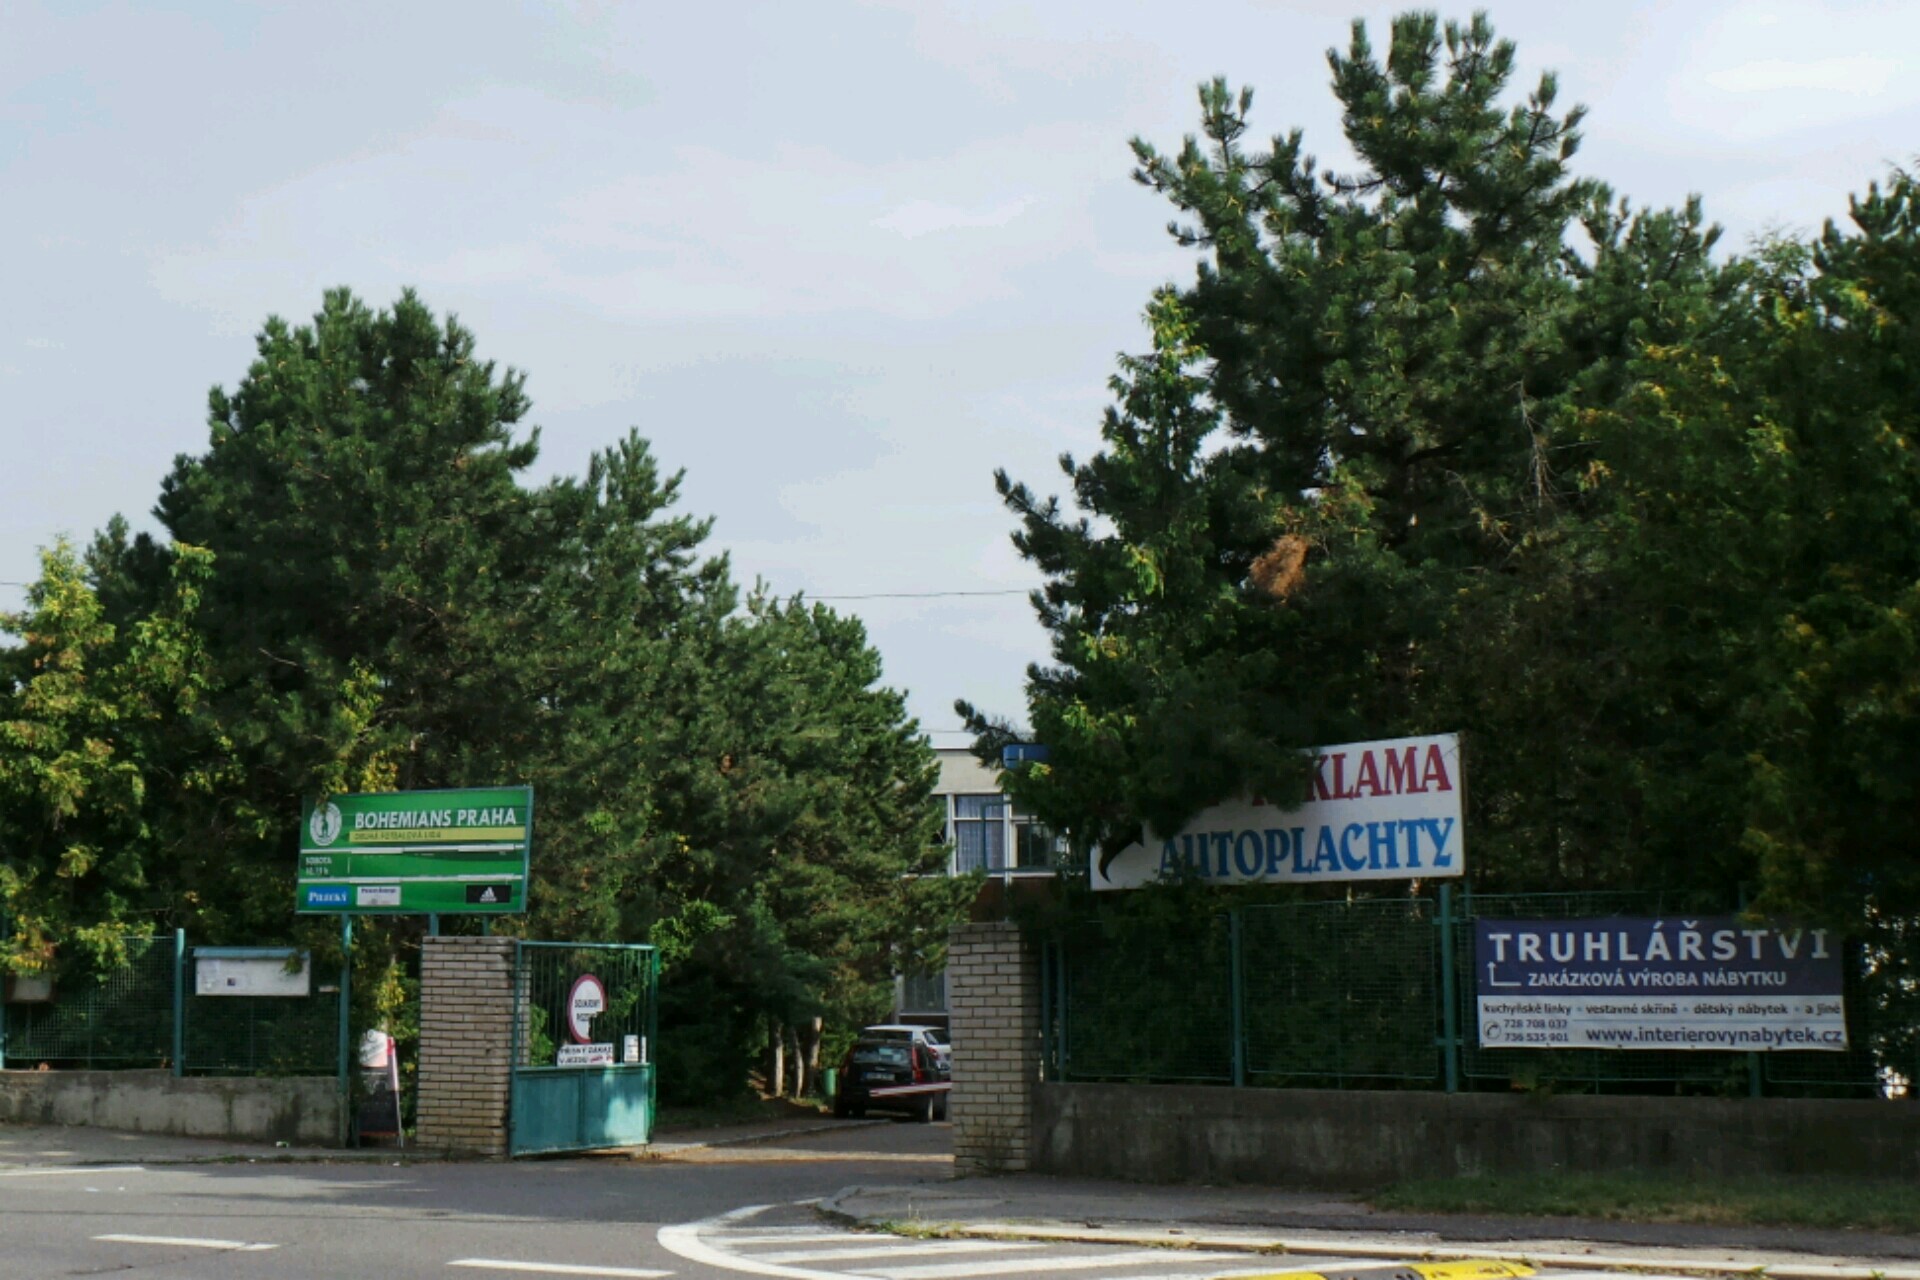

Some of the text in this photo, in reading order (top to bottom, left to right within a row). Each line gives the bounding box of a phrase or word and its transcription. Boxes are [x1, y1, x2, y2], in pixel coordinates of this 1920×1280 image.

[355, 810, 451, 829] BOHEMIANS
[457, 807, 516, 827] PRAHA
[1158, 816, 1454, 880] AUTOPLACHTY
[1528, 966, 1787, 987] ZAKÁZKOVÁ VÝROBA NÁBYTKU
[1483, 1002, 1841, 1017] kuchyňské linky vestavné skříně dětský nábytek a jiné
[1585, 1023, 1842, 1046] www.interierovynabytek.cz
